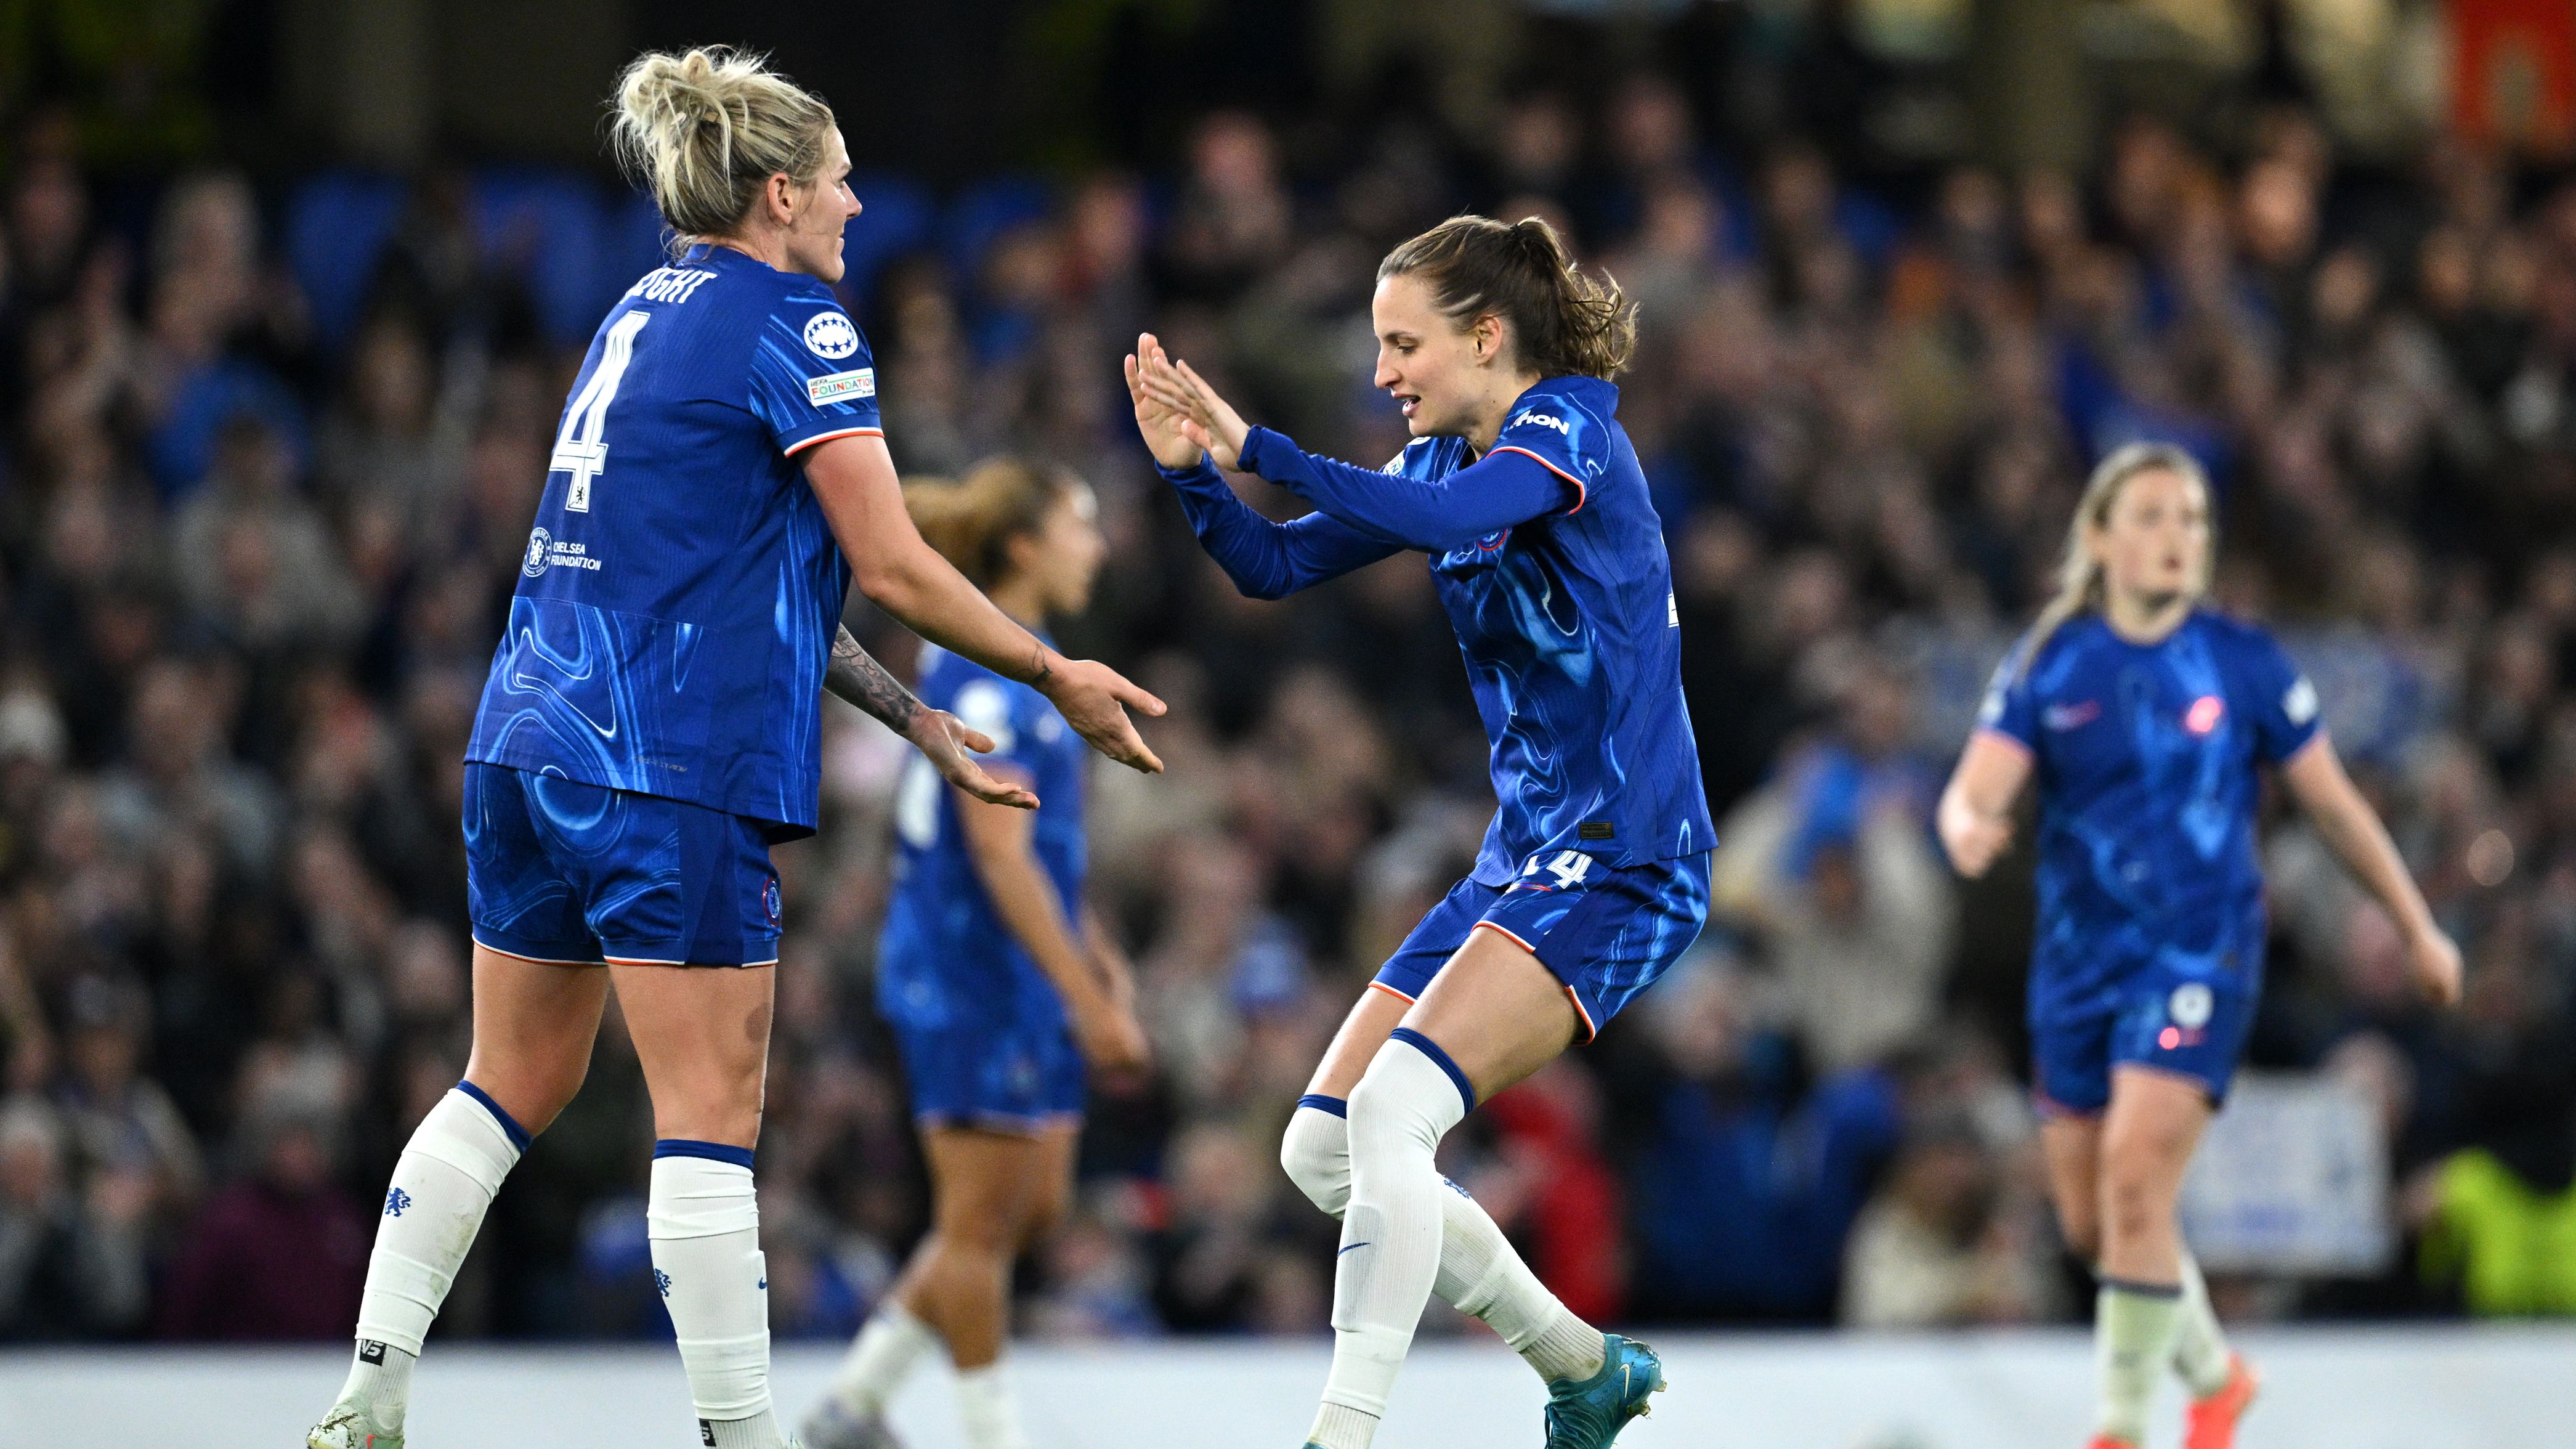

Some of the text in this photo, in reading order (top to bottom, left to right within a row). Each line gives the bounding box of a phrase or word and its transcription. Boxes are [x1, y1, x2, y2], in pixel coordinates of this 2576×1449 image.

[811, 377, 874, 397] FOUNDATION
[549, 310, 650, 513] 4
[553, 542, 585, 554] CELSEA
